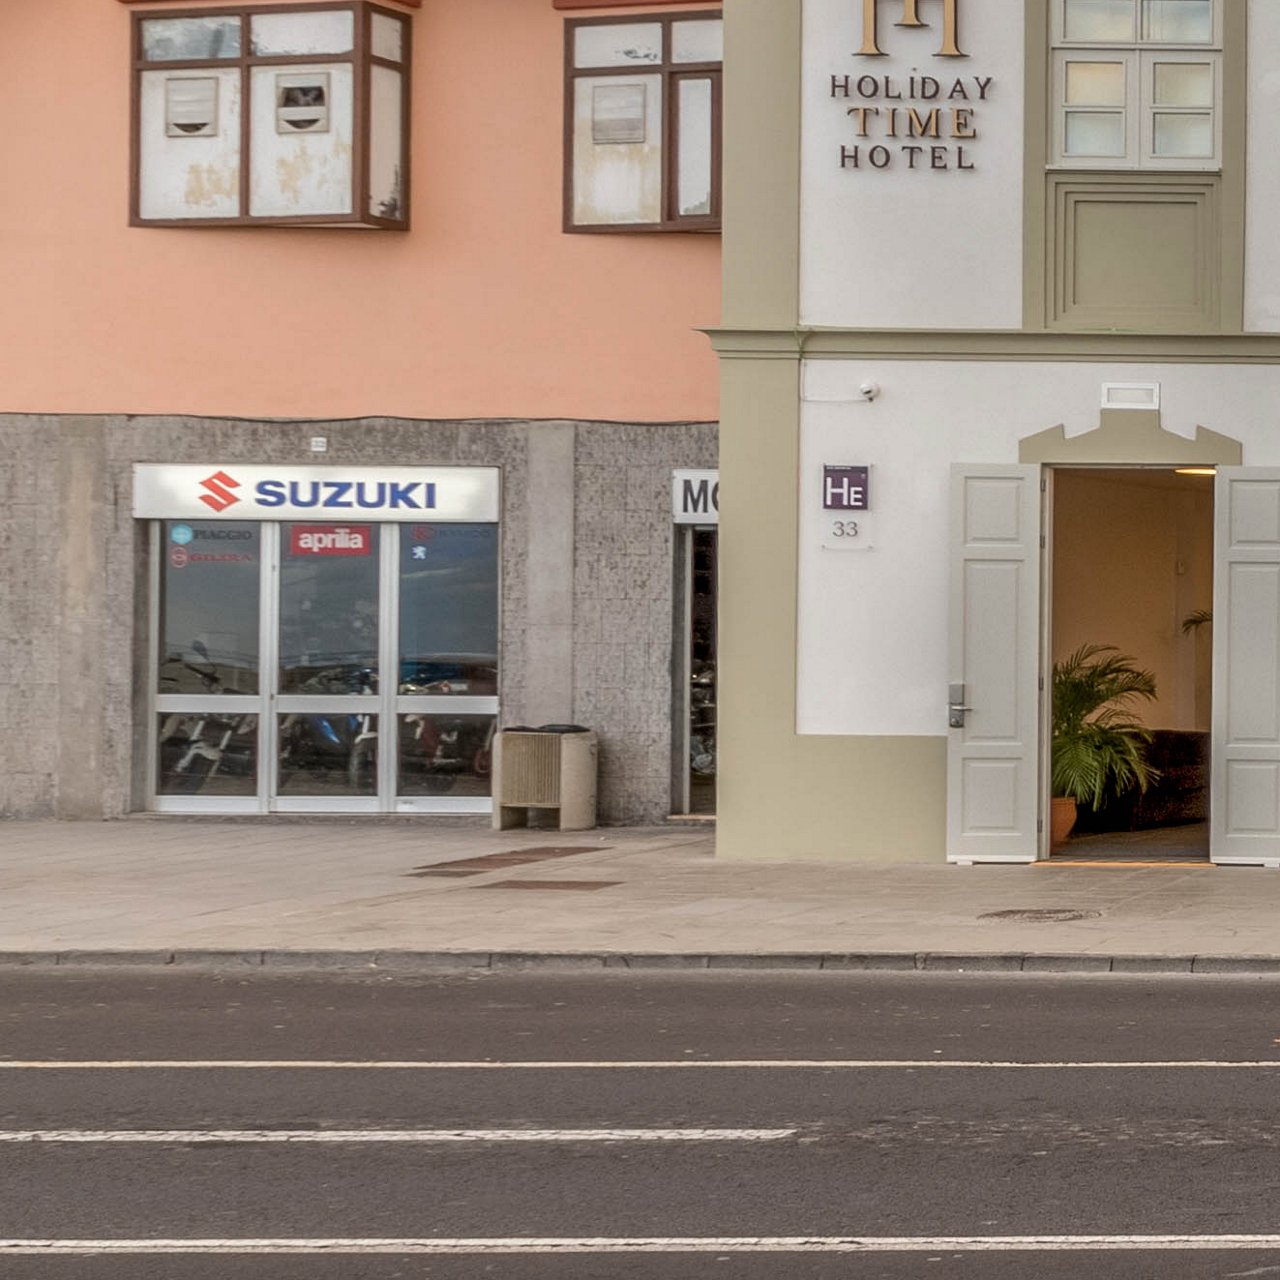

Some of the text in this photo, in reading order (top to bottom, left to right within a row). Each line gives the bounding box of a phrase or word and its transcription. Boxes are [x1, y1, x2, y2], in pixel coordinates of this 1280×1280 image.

[847, 107, 977, 139] TIME
[840, 145, 974, 170] HOTEL
[255, 480, 437, 509] SUZUKI
[298, 528, 364, 552] aprilia
[832, 521, 859, 538] 33
